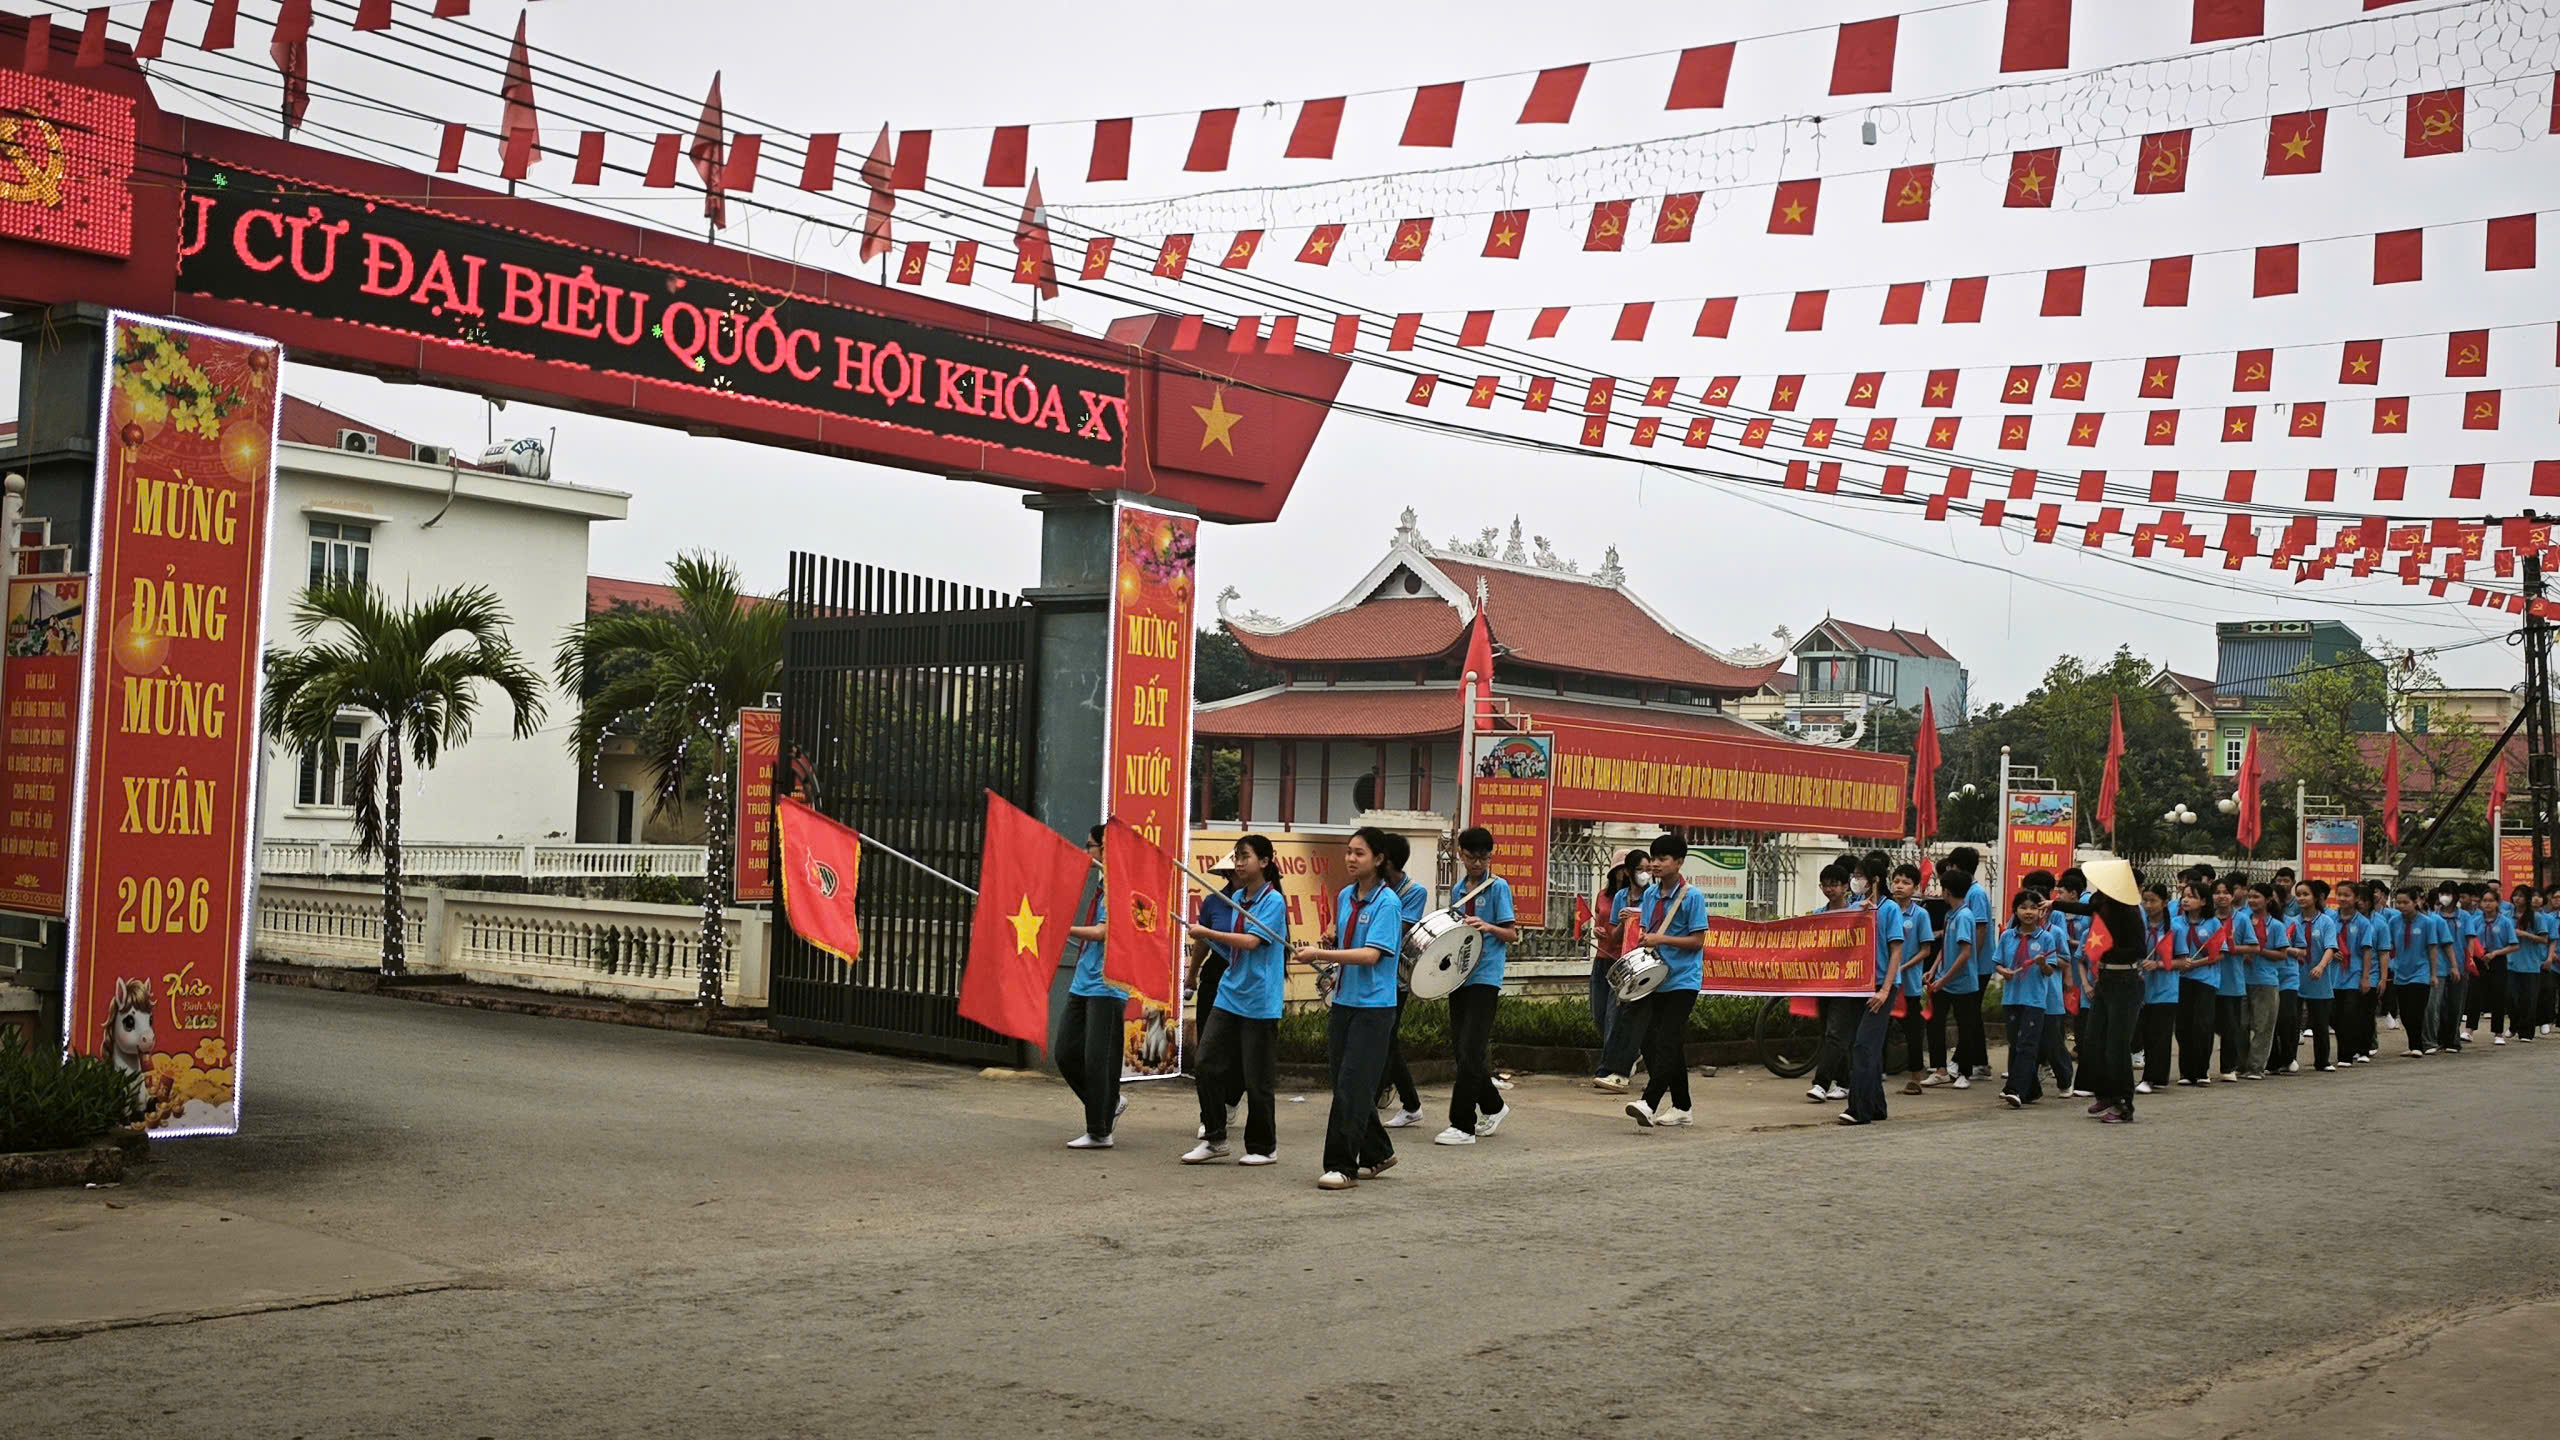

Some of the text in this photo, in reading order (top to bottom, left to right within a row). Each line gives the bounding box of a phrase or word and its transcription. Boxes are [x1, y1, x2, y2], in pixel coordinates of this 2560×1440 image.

[233, 206, 350, 282] CỬ
[361, 233, 485, 317] ĐẠI
[661, 301, 822, 381] QUỐC
[833, 336, 926, 406] HỘI
[934, 364, 1069, 433] KHÓA
[132, 468, 237, 546] MỪNG
[130, 563, 228, 642] ĐẢNG
[1127, 607, 1179, 660] MỪNG
[120, 665, 225, 740] MỪNG
[1132, 674, 1169, 728] ĐẤT
[746, 782, 771, 797] CƯỜN
[1124, 746, 1171, 797] NƯỚC
[119, 766, 216, 836] XUÂN
[747, 800, 771, 815] TRƯỜ
[2013, 830, 2067, 845] VINH QUANG
[116, 876, 210, 934] 2026
[1821, 961, 1840, 980] 2026
